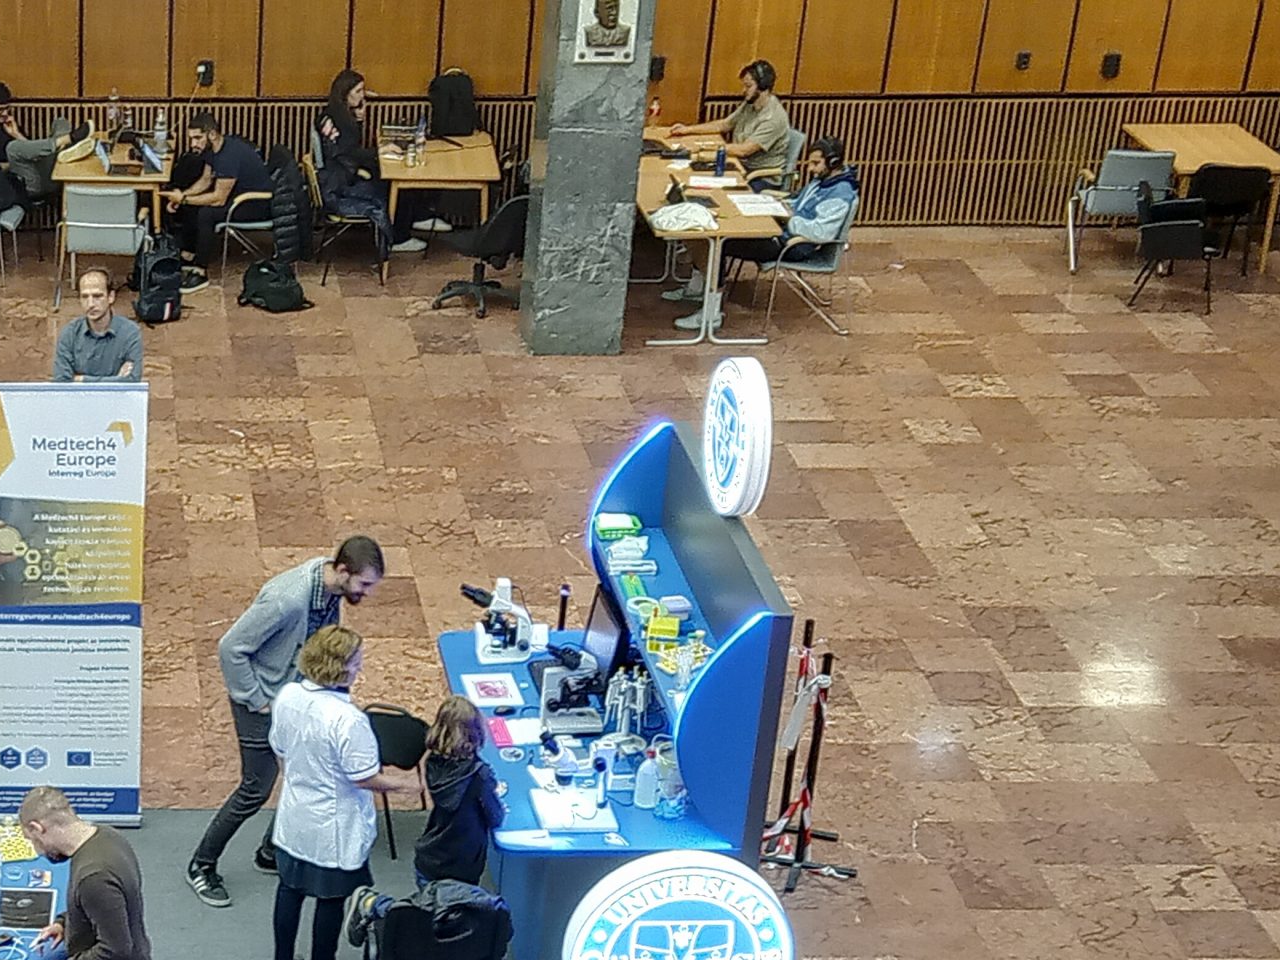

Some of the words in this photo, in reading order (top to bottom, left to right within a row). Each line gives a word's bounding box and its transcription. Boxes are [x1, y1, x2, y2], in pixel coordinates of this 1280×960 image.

[31, 436, 117, 451] Medtech4
[56, 453, 117, 469] Europe
[48, 469, 84, 478] Interreg
[85, 469, 117, 478] Europe
[602, 874, 771, 925] UNIVERSITAS
